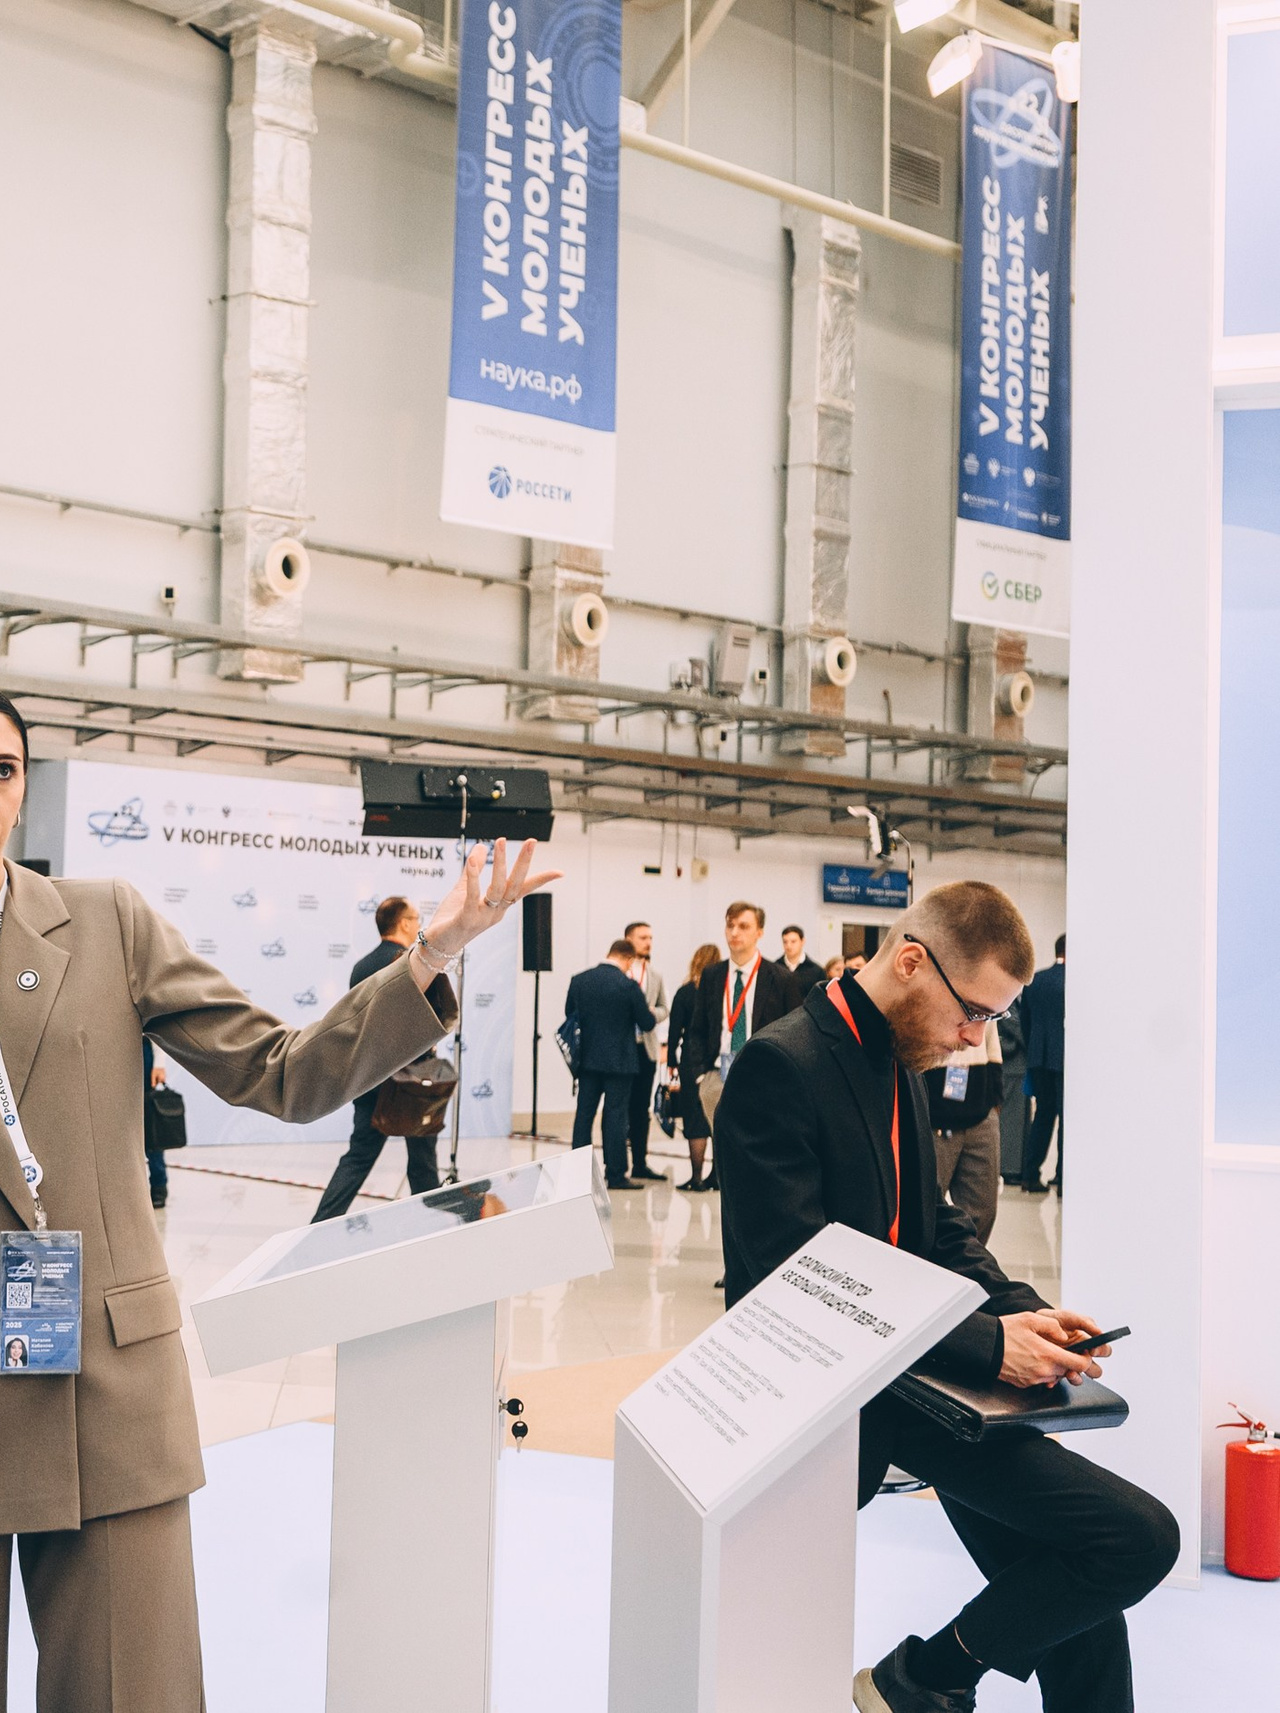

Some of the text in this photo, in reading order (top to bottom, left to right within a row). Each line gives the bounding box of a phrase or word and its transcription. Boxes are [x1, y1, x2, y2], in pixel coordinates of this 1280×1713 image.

[482, 0, 518, 320] V КОНГРЕСС
[520, 50, 555, 336] МОЛОДЫХ
[558, 123, 589, 346] УЧЕНЫХ
[979, 174, 1002, 437] V КОНГРЕСС
[1004, 211, 1026, 446] МОЛОДЫХ
[480, 358, 582, 404] наука.рф
[1029, 268, 1050, 452] УЧЕНЫХ
[516, 478, 572, 502] РОССЕТИ
[1003, 579, 1042, 603] СБЕР
[163, 826, 174, 841] V
[181, 828, 274, 849] КОНГРЕСС
[280, 835, 370, 856] МОЛОДЫХ
[377, 841, 444, 860] УЧЕНЫХ
[401, 866, 445, 879] наука.рф
[780, 1269, 896, 1338] АЭС БОЛЬШОЙ МОЩНОСТИ ВВЭР-1200
[798, 1255, 873, 1298] ФЛАГМАНСКИЙ РЕАКТОР
